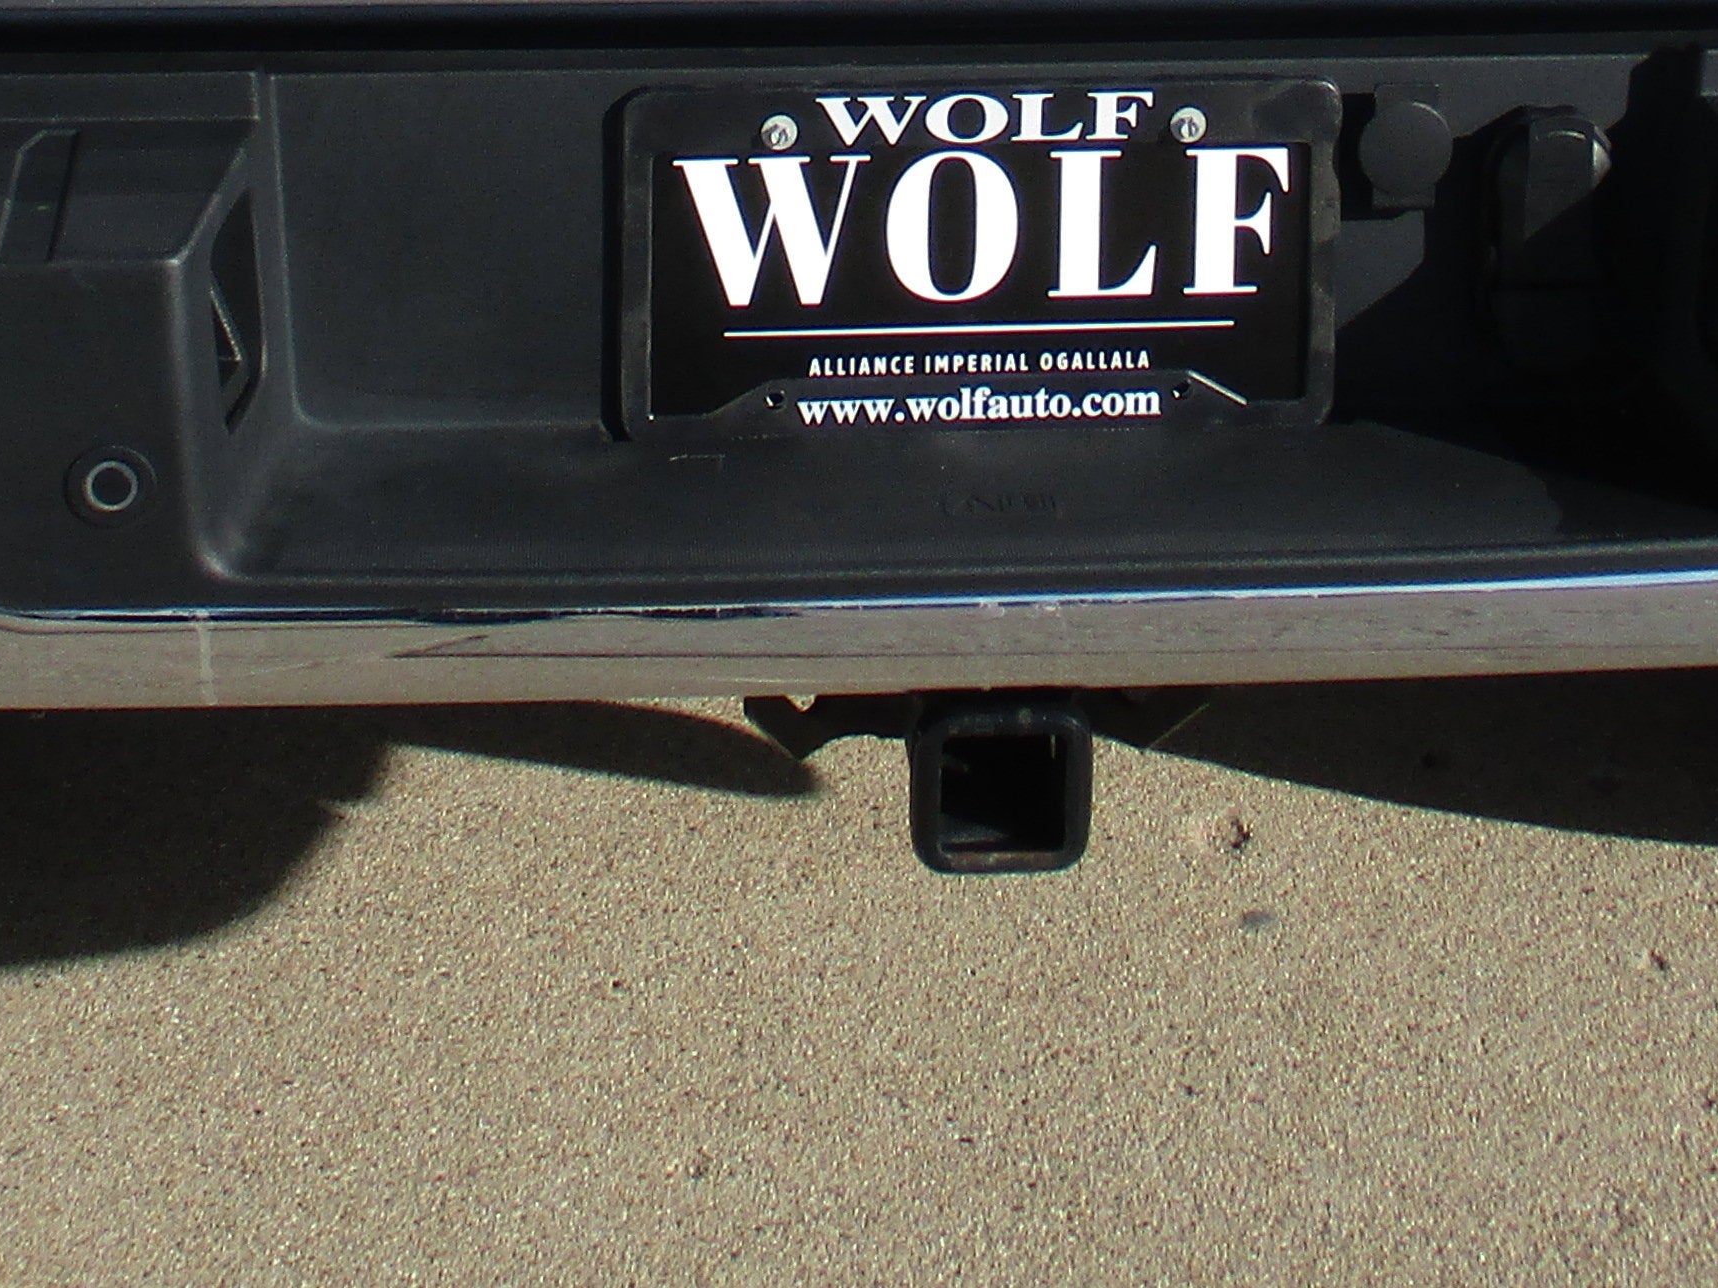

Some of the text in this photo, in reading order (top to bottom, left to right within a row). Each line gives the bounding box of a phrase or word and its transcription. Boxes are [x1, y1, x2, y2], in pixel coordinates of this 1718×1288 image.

[815, 91, 1155, 146] WOLF
[672, 146, 1290, 308] WOLF
[808, 350, 1151, 378] ALLIANCE IMPERIAL OGALLALA
[797, 385, 1162, 426] www.wolfauto.com
